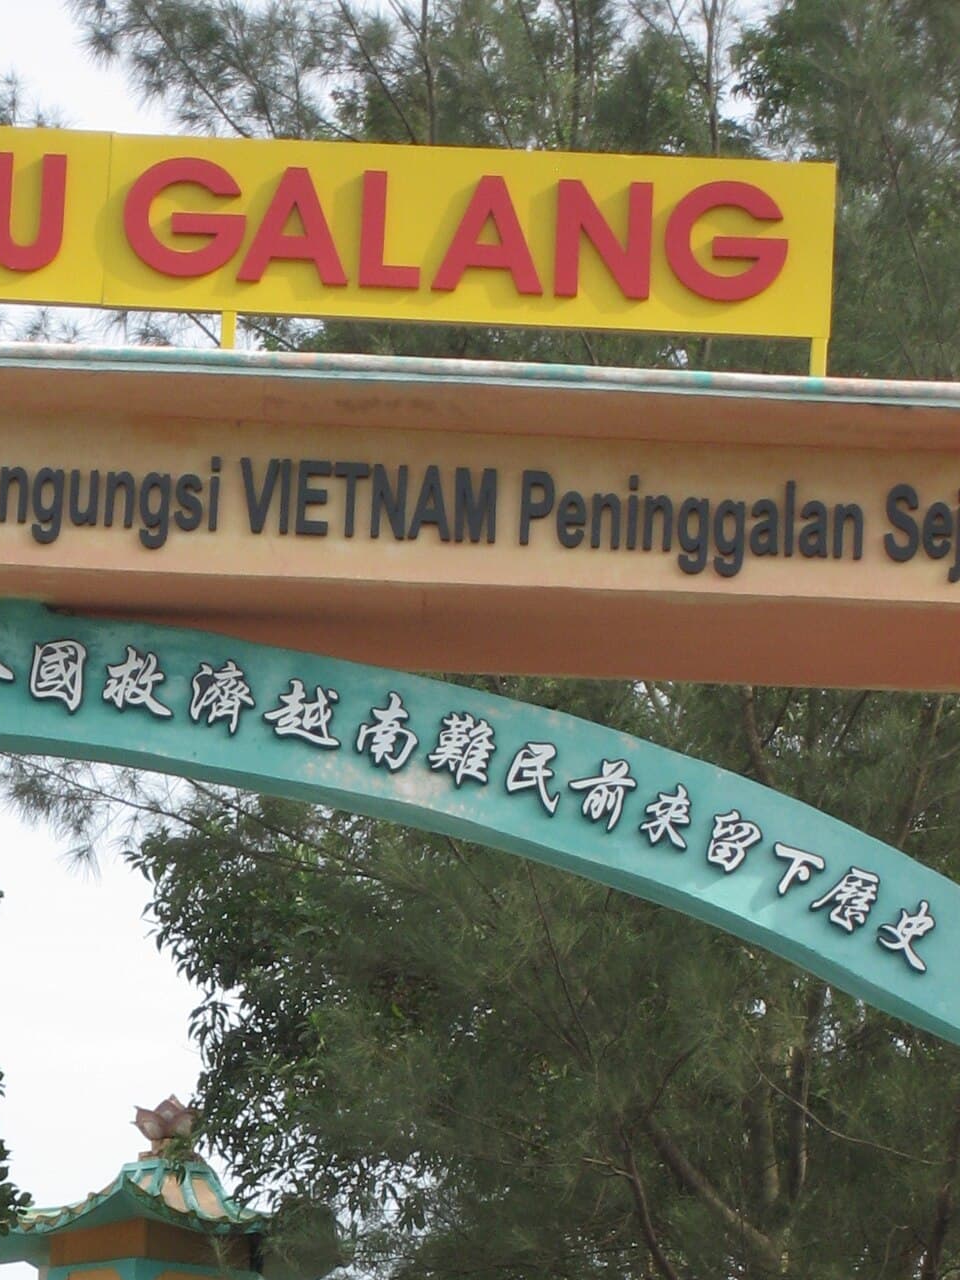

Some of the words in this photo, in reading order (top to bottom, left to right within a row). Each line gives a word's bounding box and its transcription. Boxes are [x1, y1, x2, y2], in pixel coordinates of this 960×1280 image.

[123, 157, 789, 302] GALANG
[240, 457, 498, 544] VIETNAM
[519, 470, 865, 578] Peninggalan
